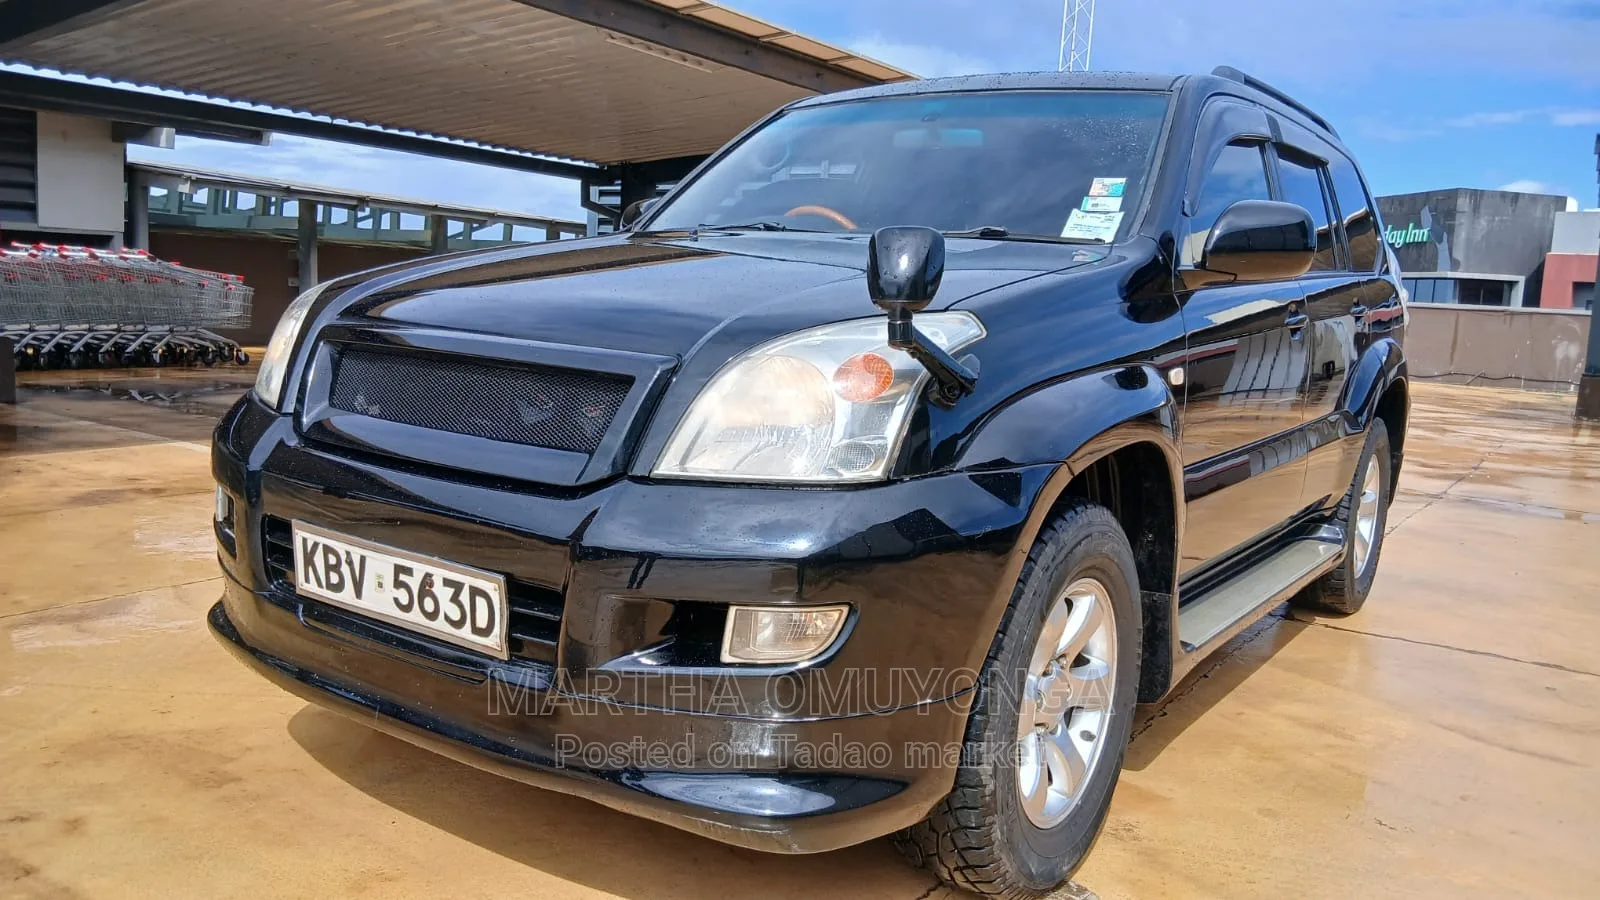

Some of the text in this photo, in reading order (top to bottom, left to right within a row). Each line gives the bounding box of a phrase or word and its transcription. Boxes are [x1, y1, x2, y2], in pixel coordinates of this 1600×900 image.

[1406, 223, 1431, 243] Inn
[301, 537, 496, 638] KBV 563D
